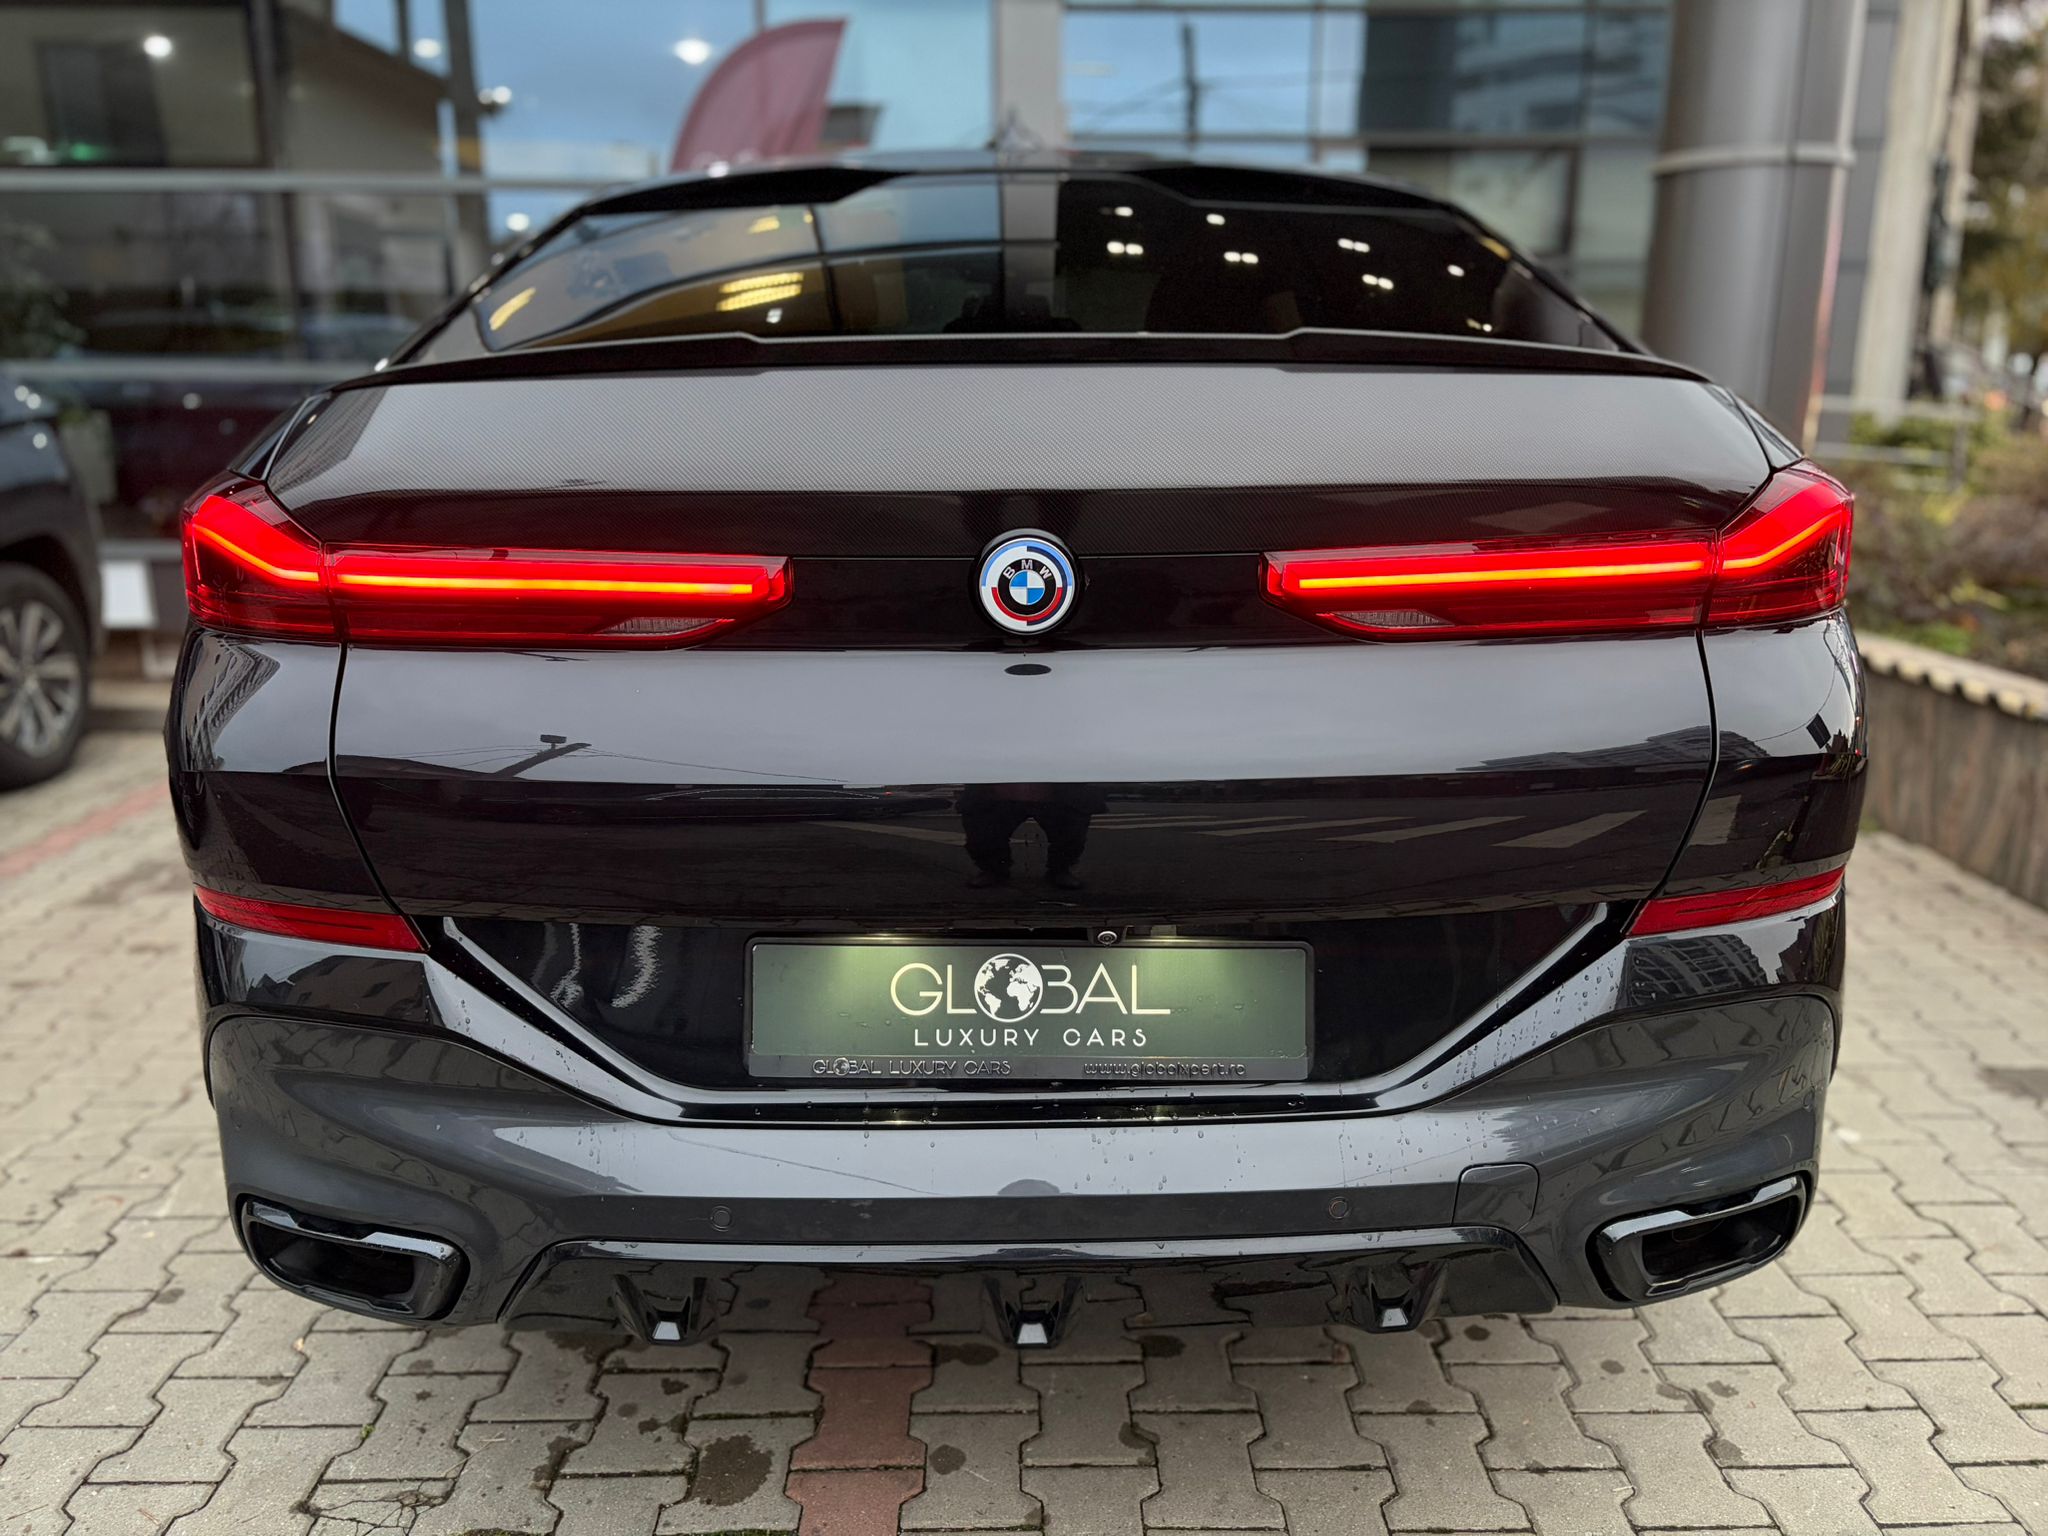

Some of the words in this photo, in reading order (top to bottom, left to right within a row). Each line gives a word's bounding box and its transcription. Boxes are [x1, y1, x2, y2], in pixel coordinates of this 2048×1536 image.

[1002, 559, 1052, 579] BMW
[890, 953, 1171, 1023] GLOBAL
[914, 1028, 1040, 1046] LUXURY
[1062, 1028, 1147, 1047] CARS
[812, 1057, 882, 1076] GLOBAL
[889, 1060, 957, 1075] LUXURY
[963, 1060, 1011, 1075] CARS
[1084, 1061, 1246, 1078] www.globalxpert.ro
